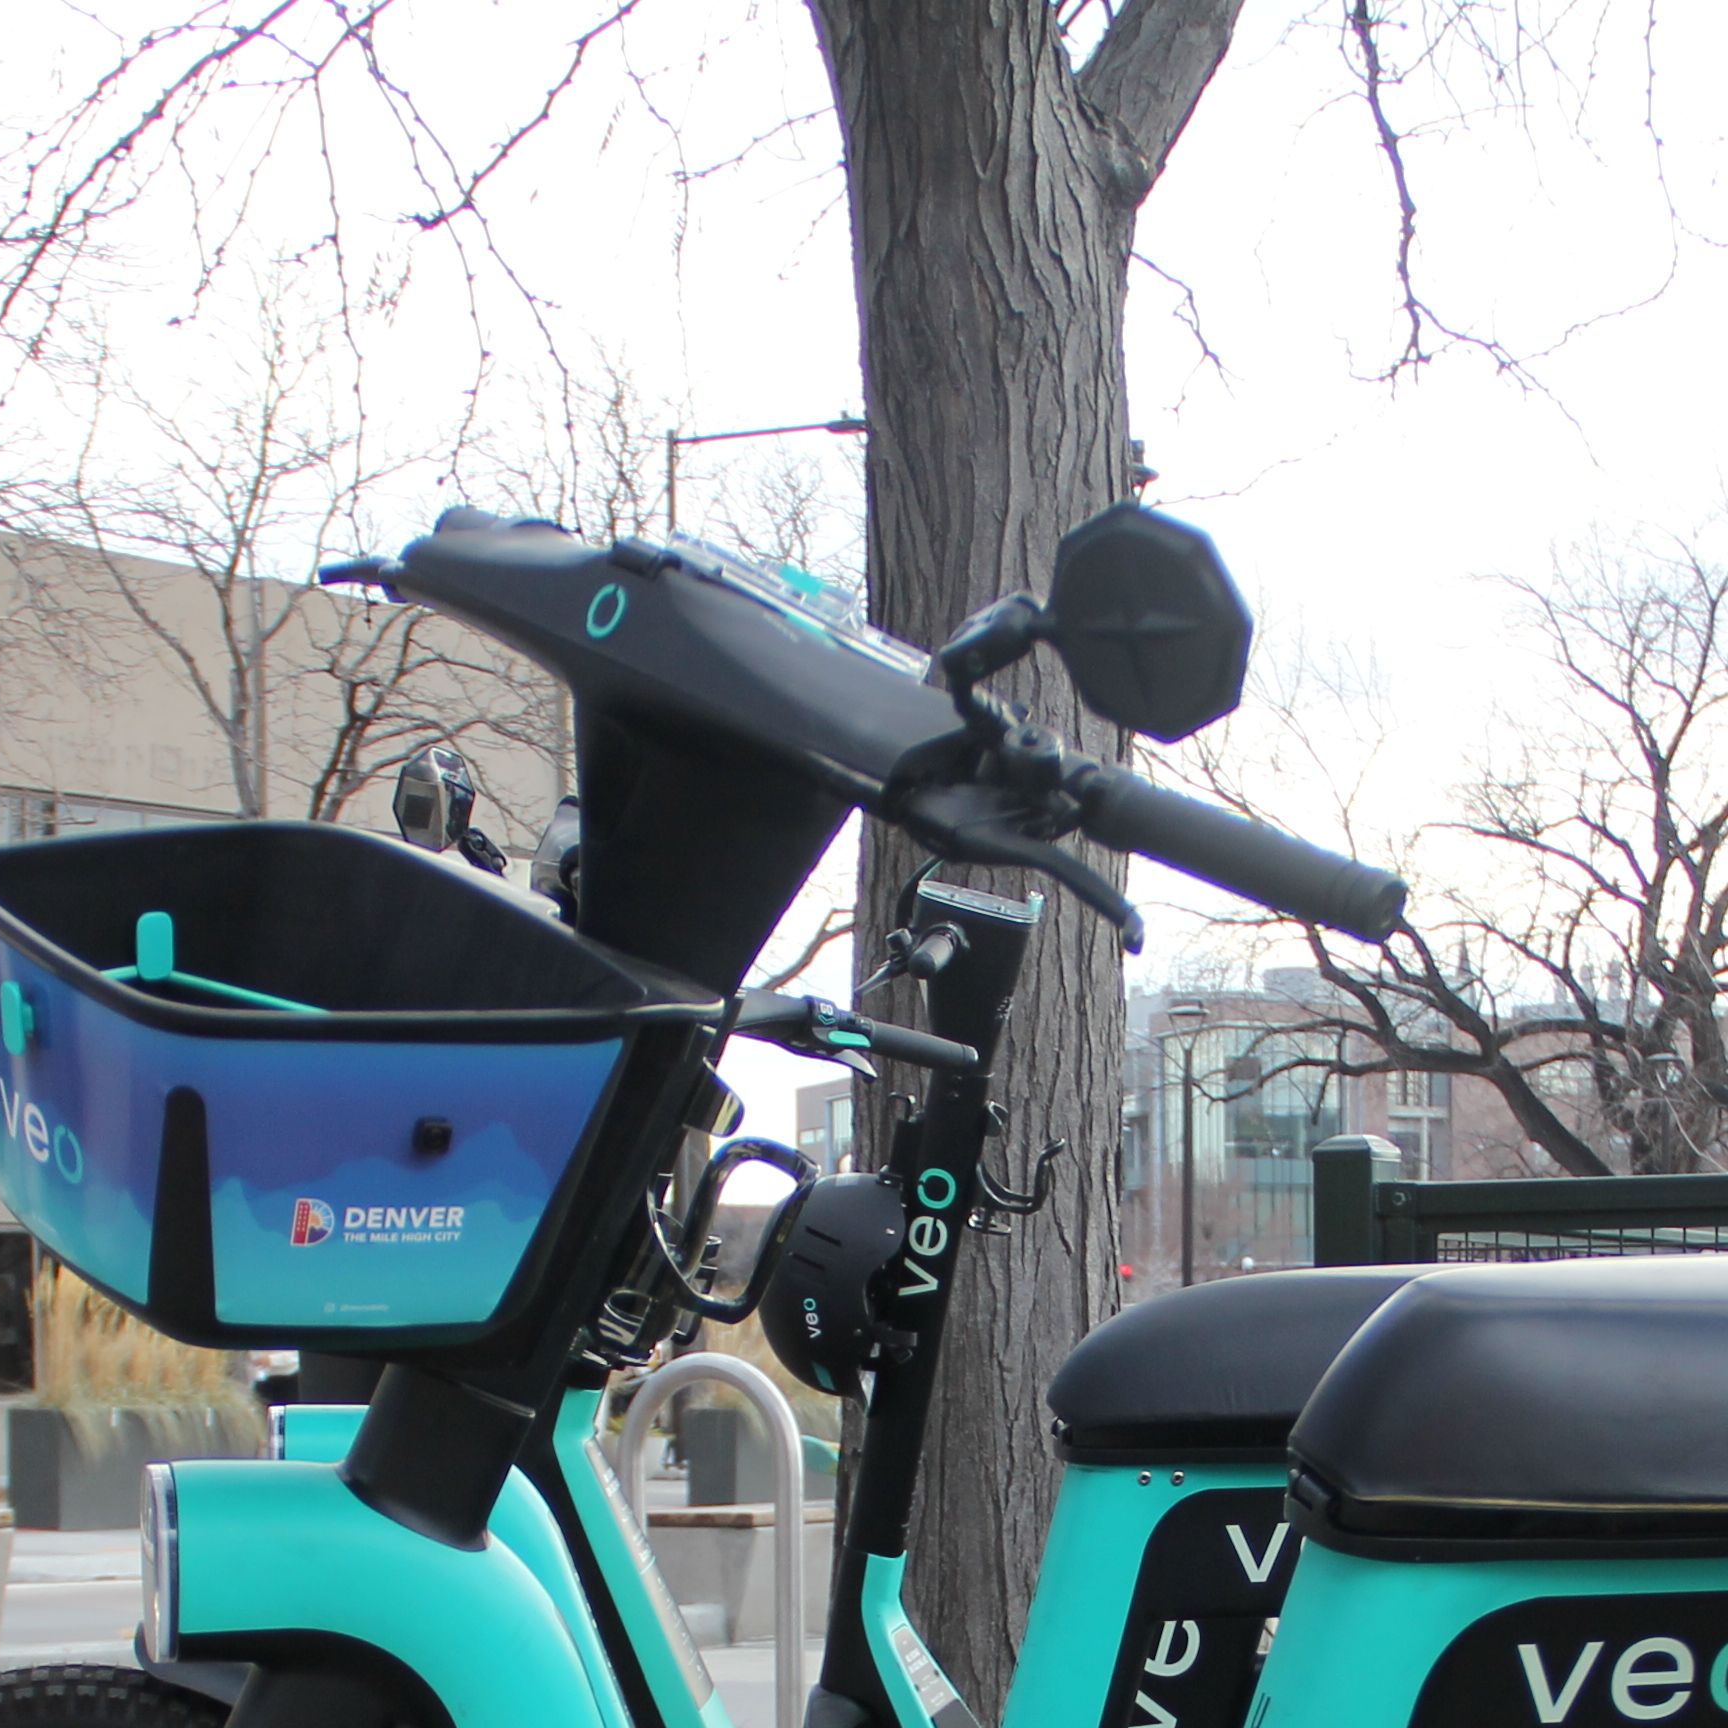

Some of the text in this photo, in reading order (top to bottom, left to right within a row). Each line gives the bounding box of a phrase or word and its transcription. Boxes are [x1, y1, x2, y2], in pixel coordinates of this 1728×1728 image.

[343, 1205, 465, 1230] DENVER
[897, 1167, 957, 1297] veo
[343, 1230, 462, 1244] THE MILE HIGH CITY
[803, 1297, 822, 1339] veo
